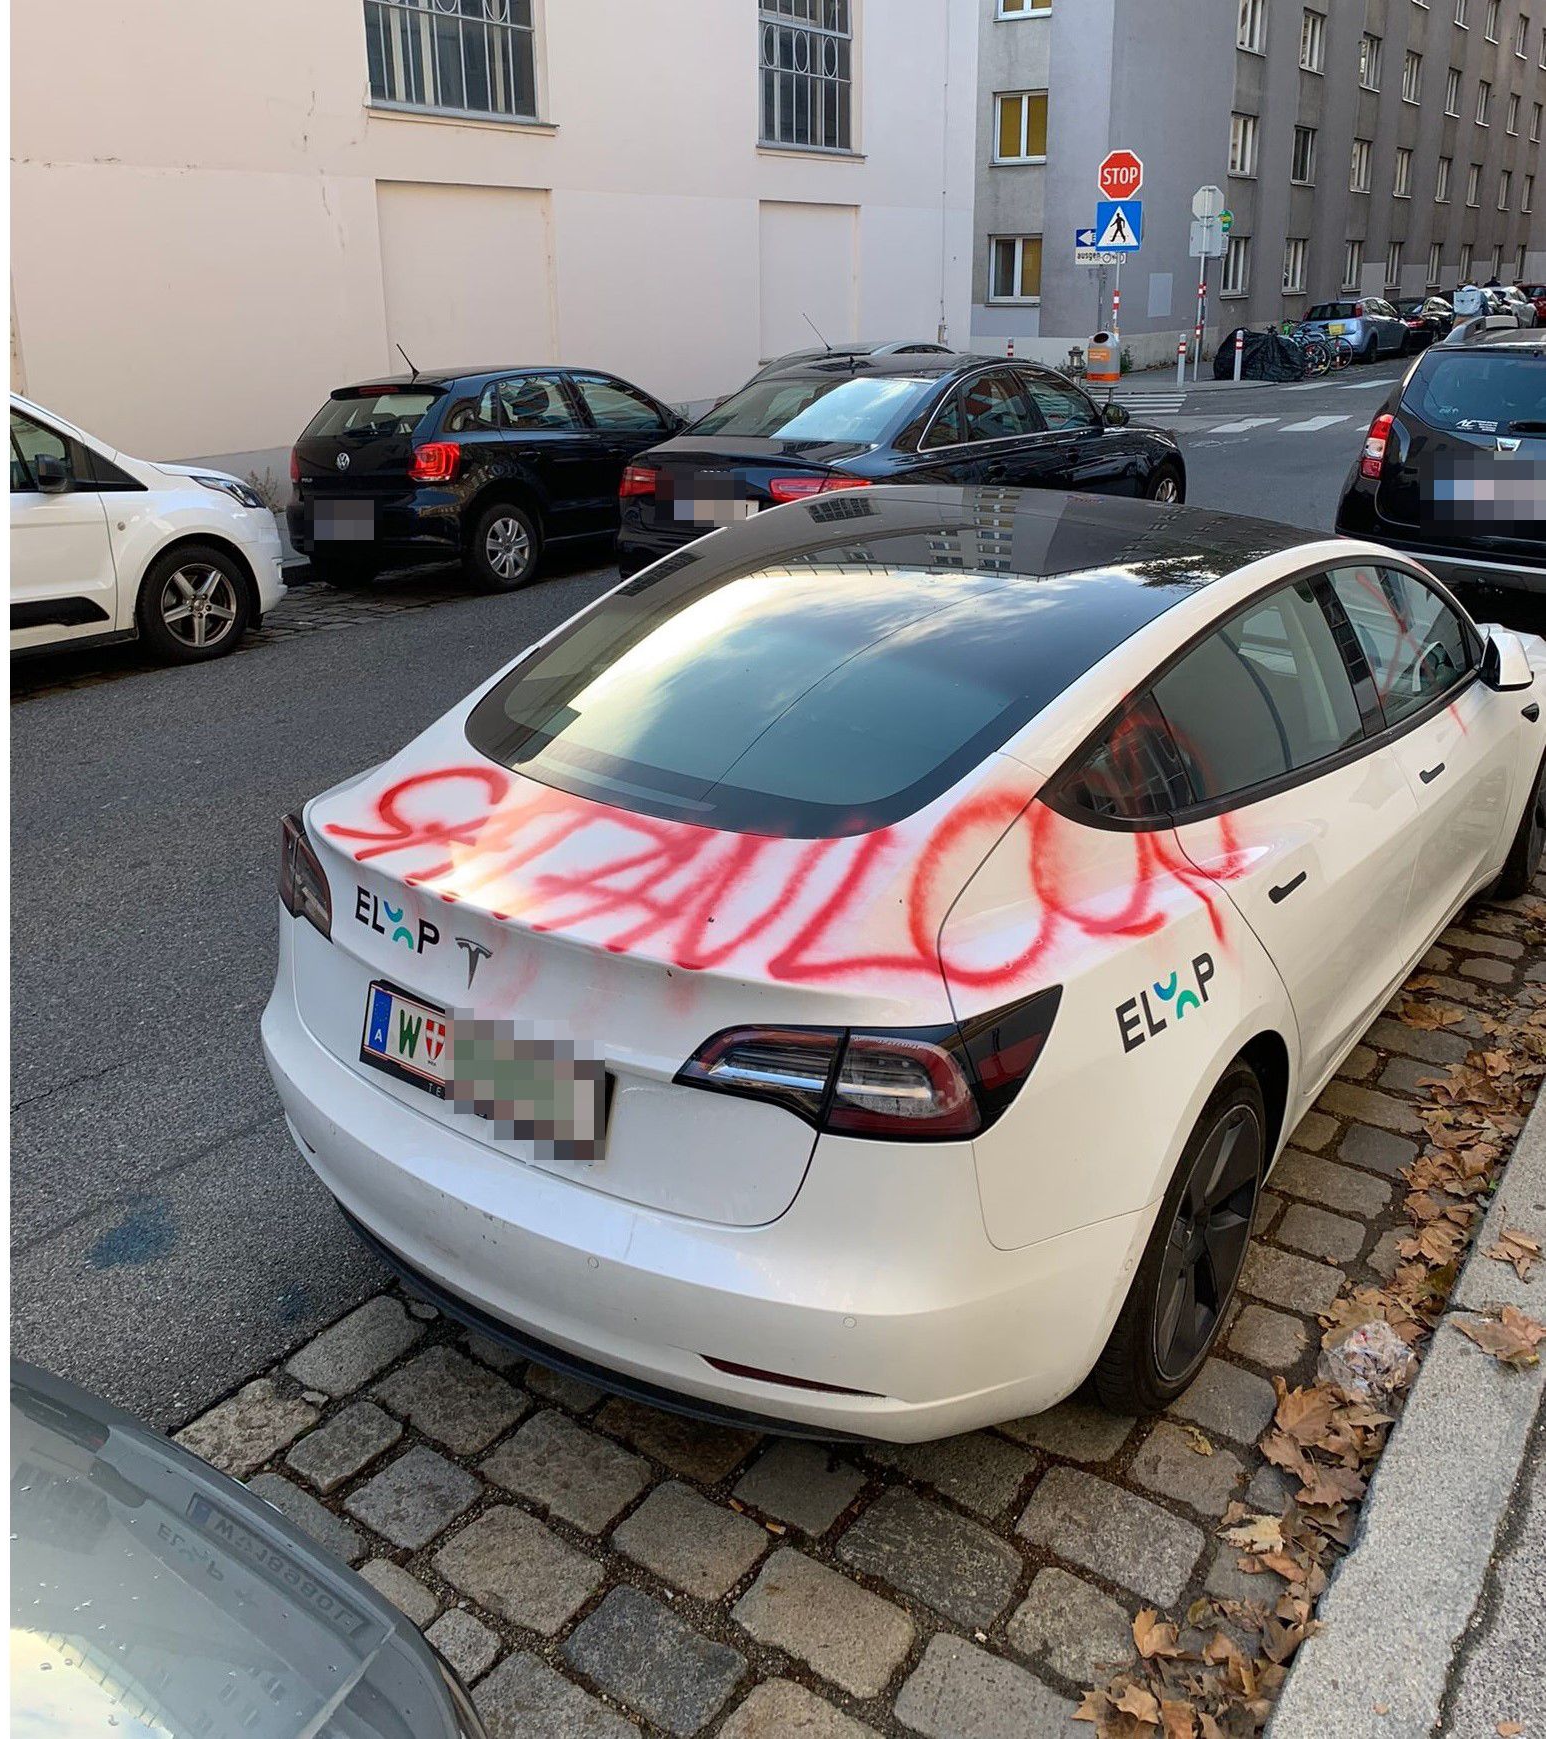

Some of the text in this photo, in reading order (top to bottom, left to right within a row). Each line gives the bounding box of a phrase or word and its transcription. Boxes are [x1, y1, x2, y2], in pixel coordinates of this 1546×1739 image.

[1103, 166, 1139, 185] STOP
[374, 1028, 383, 1043] A
[398, 1009, 422, 1059] W
